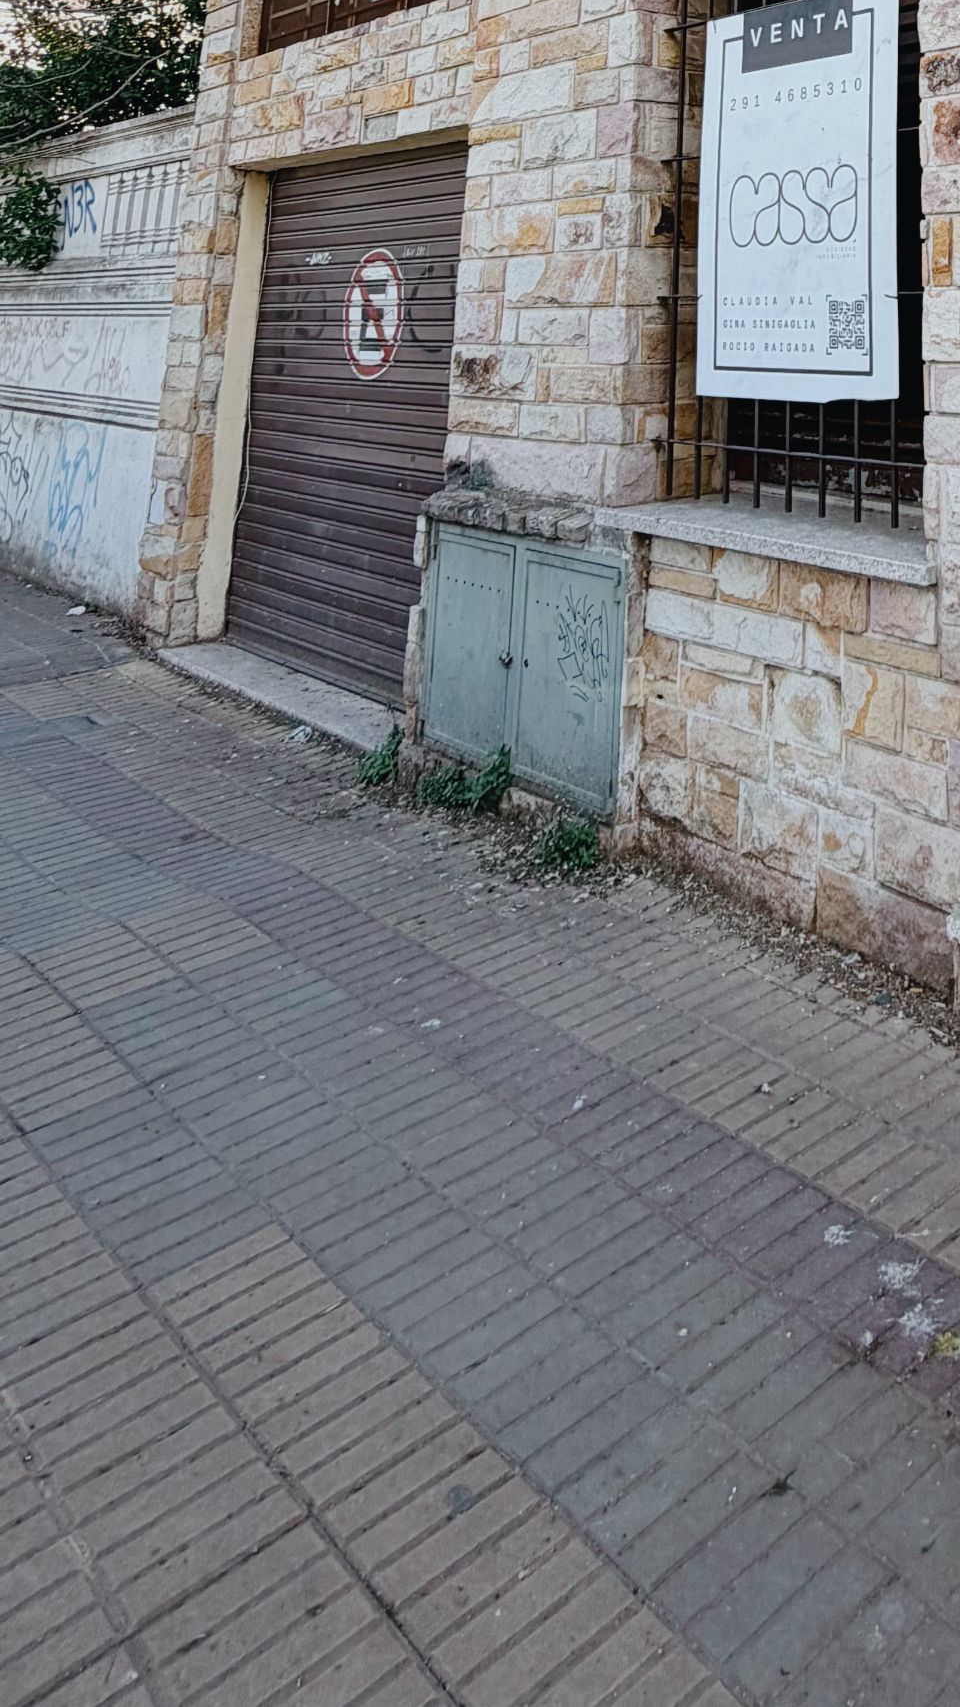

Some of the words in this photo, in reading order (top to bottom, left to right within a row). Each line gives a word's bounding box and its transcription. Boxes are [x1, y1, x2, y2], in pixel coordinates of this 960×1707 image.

[750, 8, 849, 48] VENTA
[729, 94, 761, 112] 291
[774, 76, 863, 104] 4685310
[722, 296, 778, 307] CLAUDIA
[789, 295, 814, 306] VAL
[722, 319, 746, 329] GINA
[752, 319, 816, 330] SINIGAGLIA
[722, 341, 756, 352] ROCIO
[763, 342, 816, 353] RAIGADA
